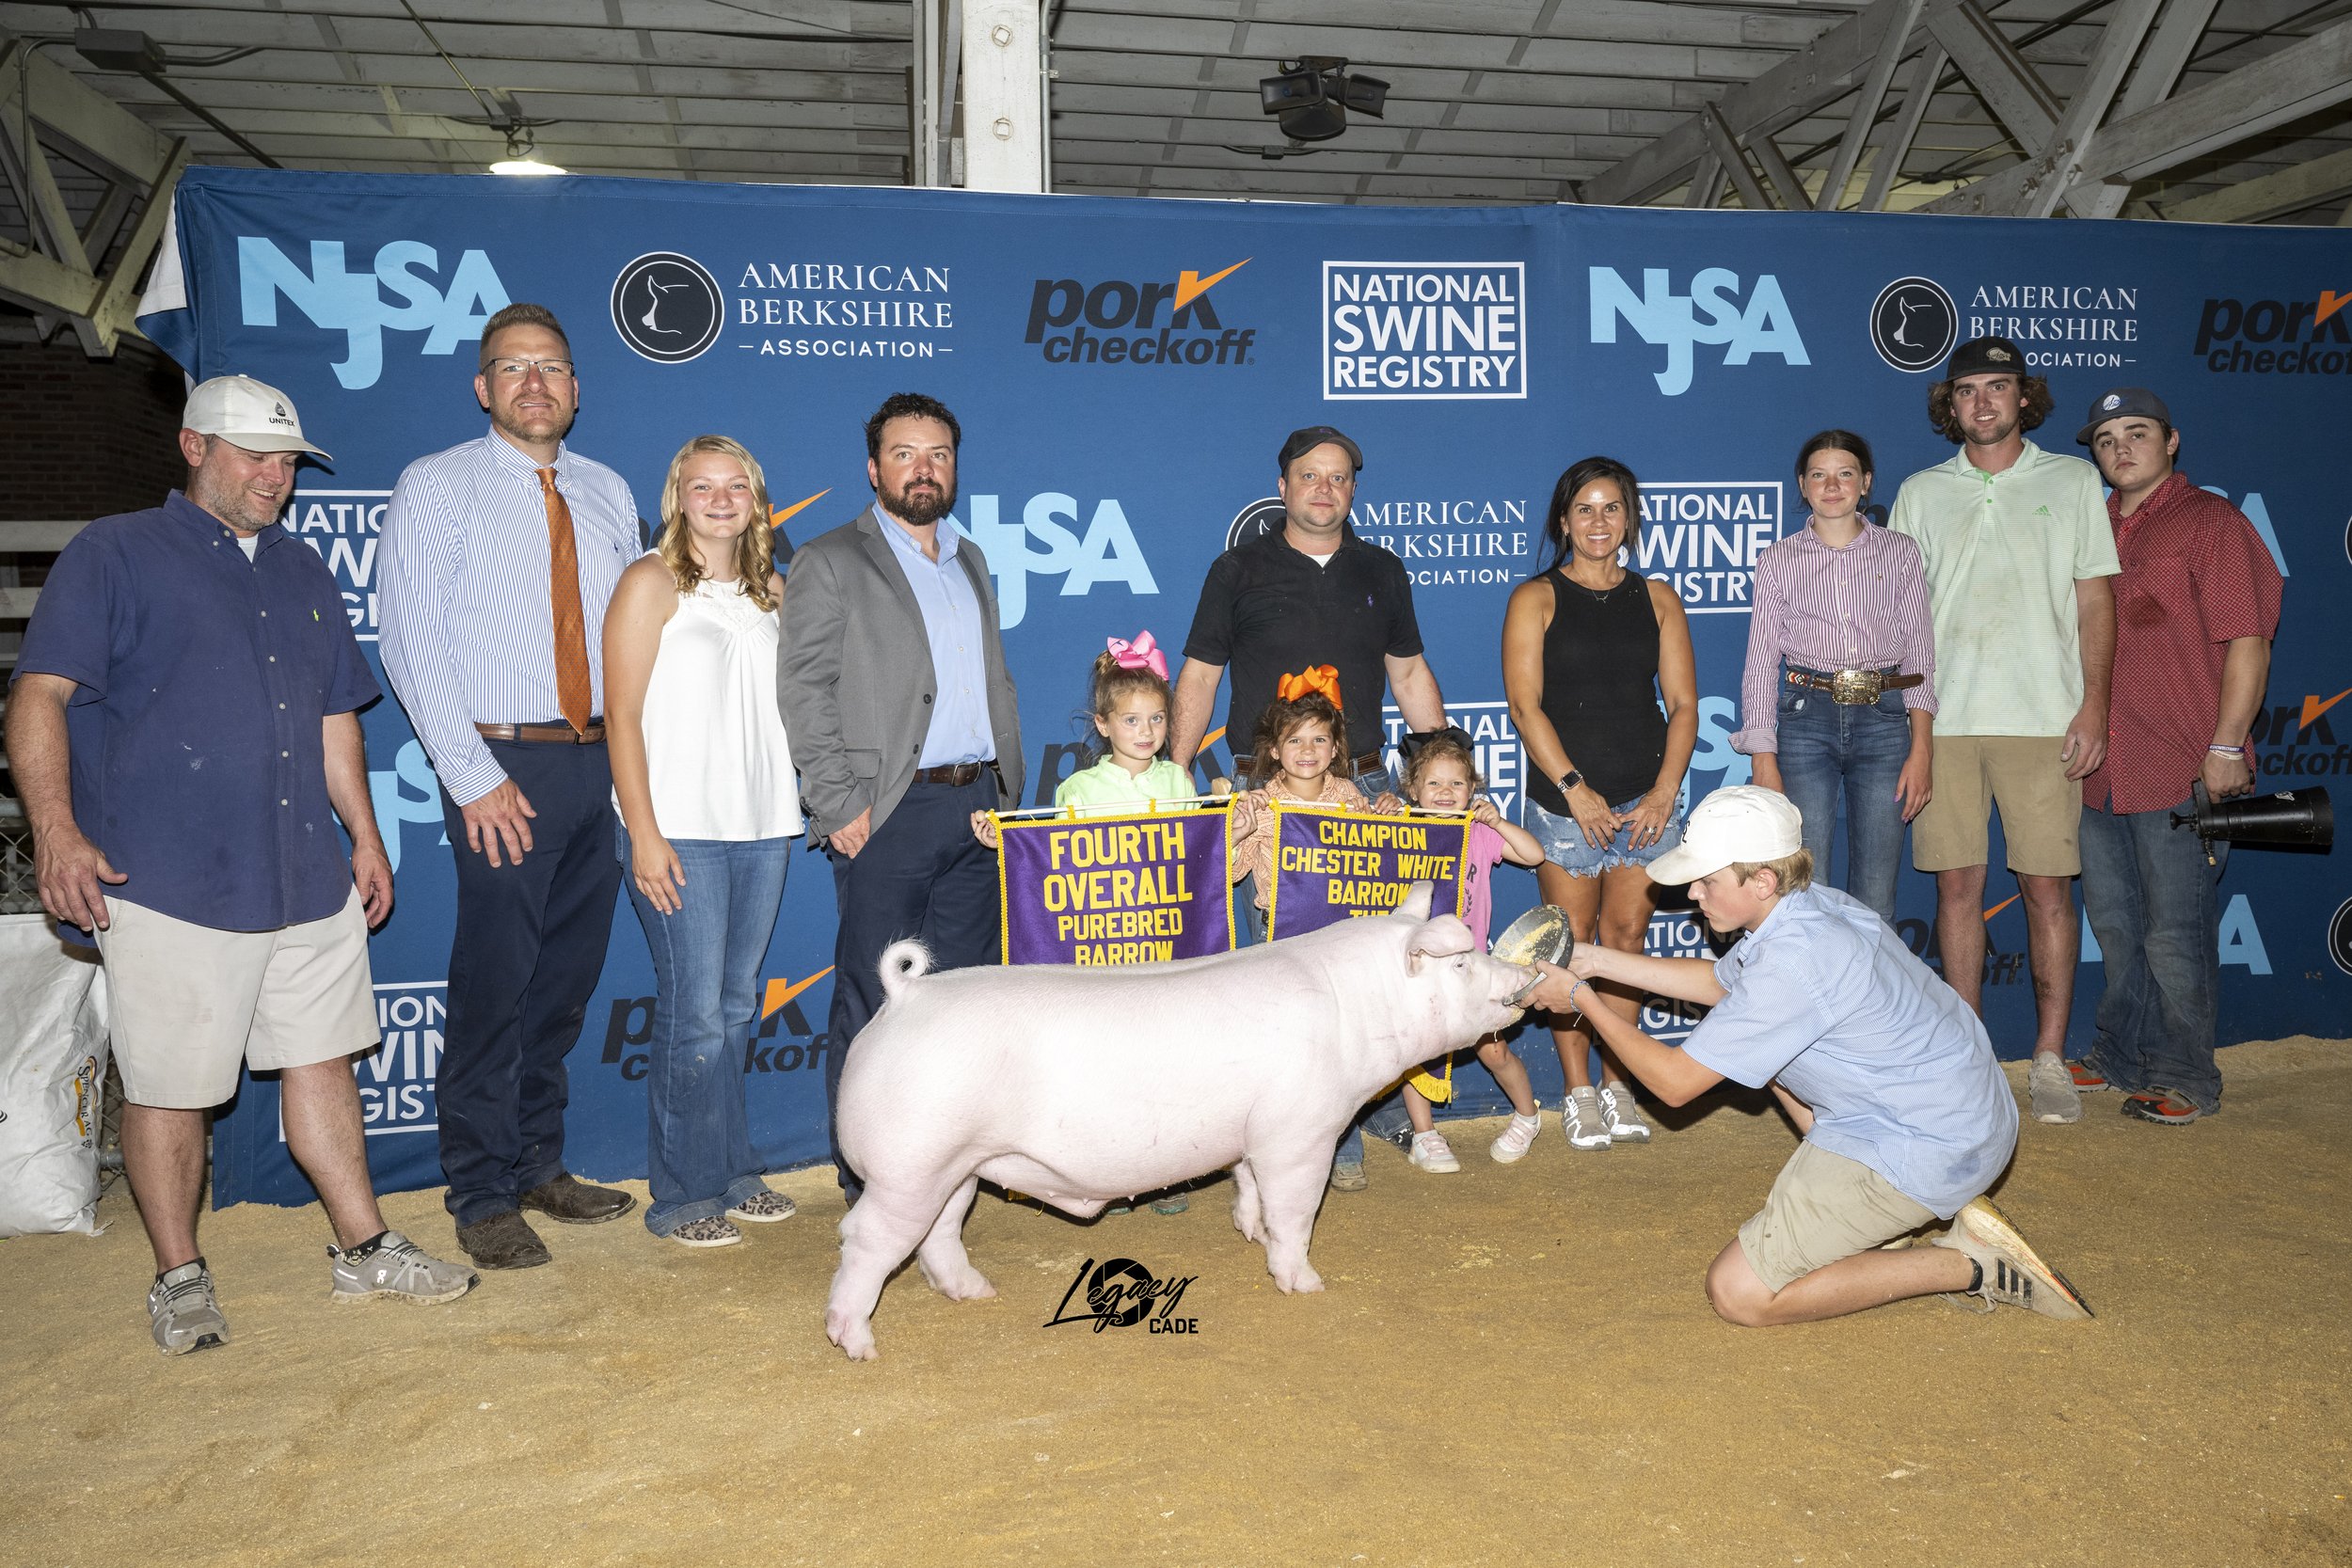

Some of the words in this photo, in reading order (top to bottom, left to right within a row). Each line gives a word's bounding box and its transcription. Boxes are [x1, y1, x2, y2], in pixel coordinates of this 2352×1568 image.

[738, 262, 950, 293] AMERICAN
[1333, 274, 1515, 302] NATIONAL
[1025, 257, 1254, 343] pork
[1970, 285, 2137, 310] AMERICAN
[739, 298, 953, 328] BERKSHIRE
[1333, 304, 1516, 352] SWINE
[1589, 266, 1811, 396] NJSA
[1969, 316, 2137, 341] BERKSHIRE
[760, 340, 933, 357] ASSOCIATION
[1042, 326, 1256, 365] checkoff
[2026, 352, 2120, 368] OCIATION
[1333, 356, 1516, 388] REGISTRY
[269, 417, 295, 427] UNITEX
[1638, 494, 1772, 521] ATIONAL
[1049, 821, 1185, 870] FOURTH
[1319, 820, 1426, 850] CHAMPION
[1280, 846, 1380, 877] CHESTER
[1397, 854, 1456, 879] WHITE
[1043, 864, 1193, 912] OVERALL
[1057, 908, 1183, 941] PUREBRED
[1074, 941, 1173, 966] BARROW
